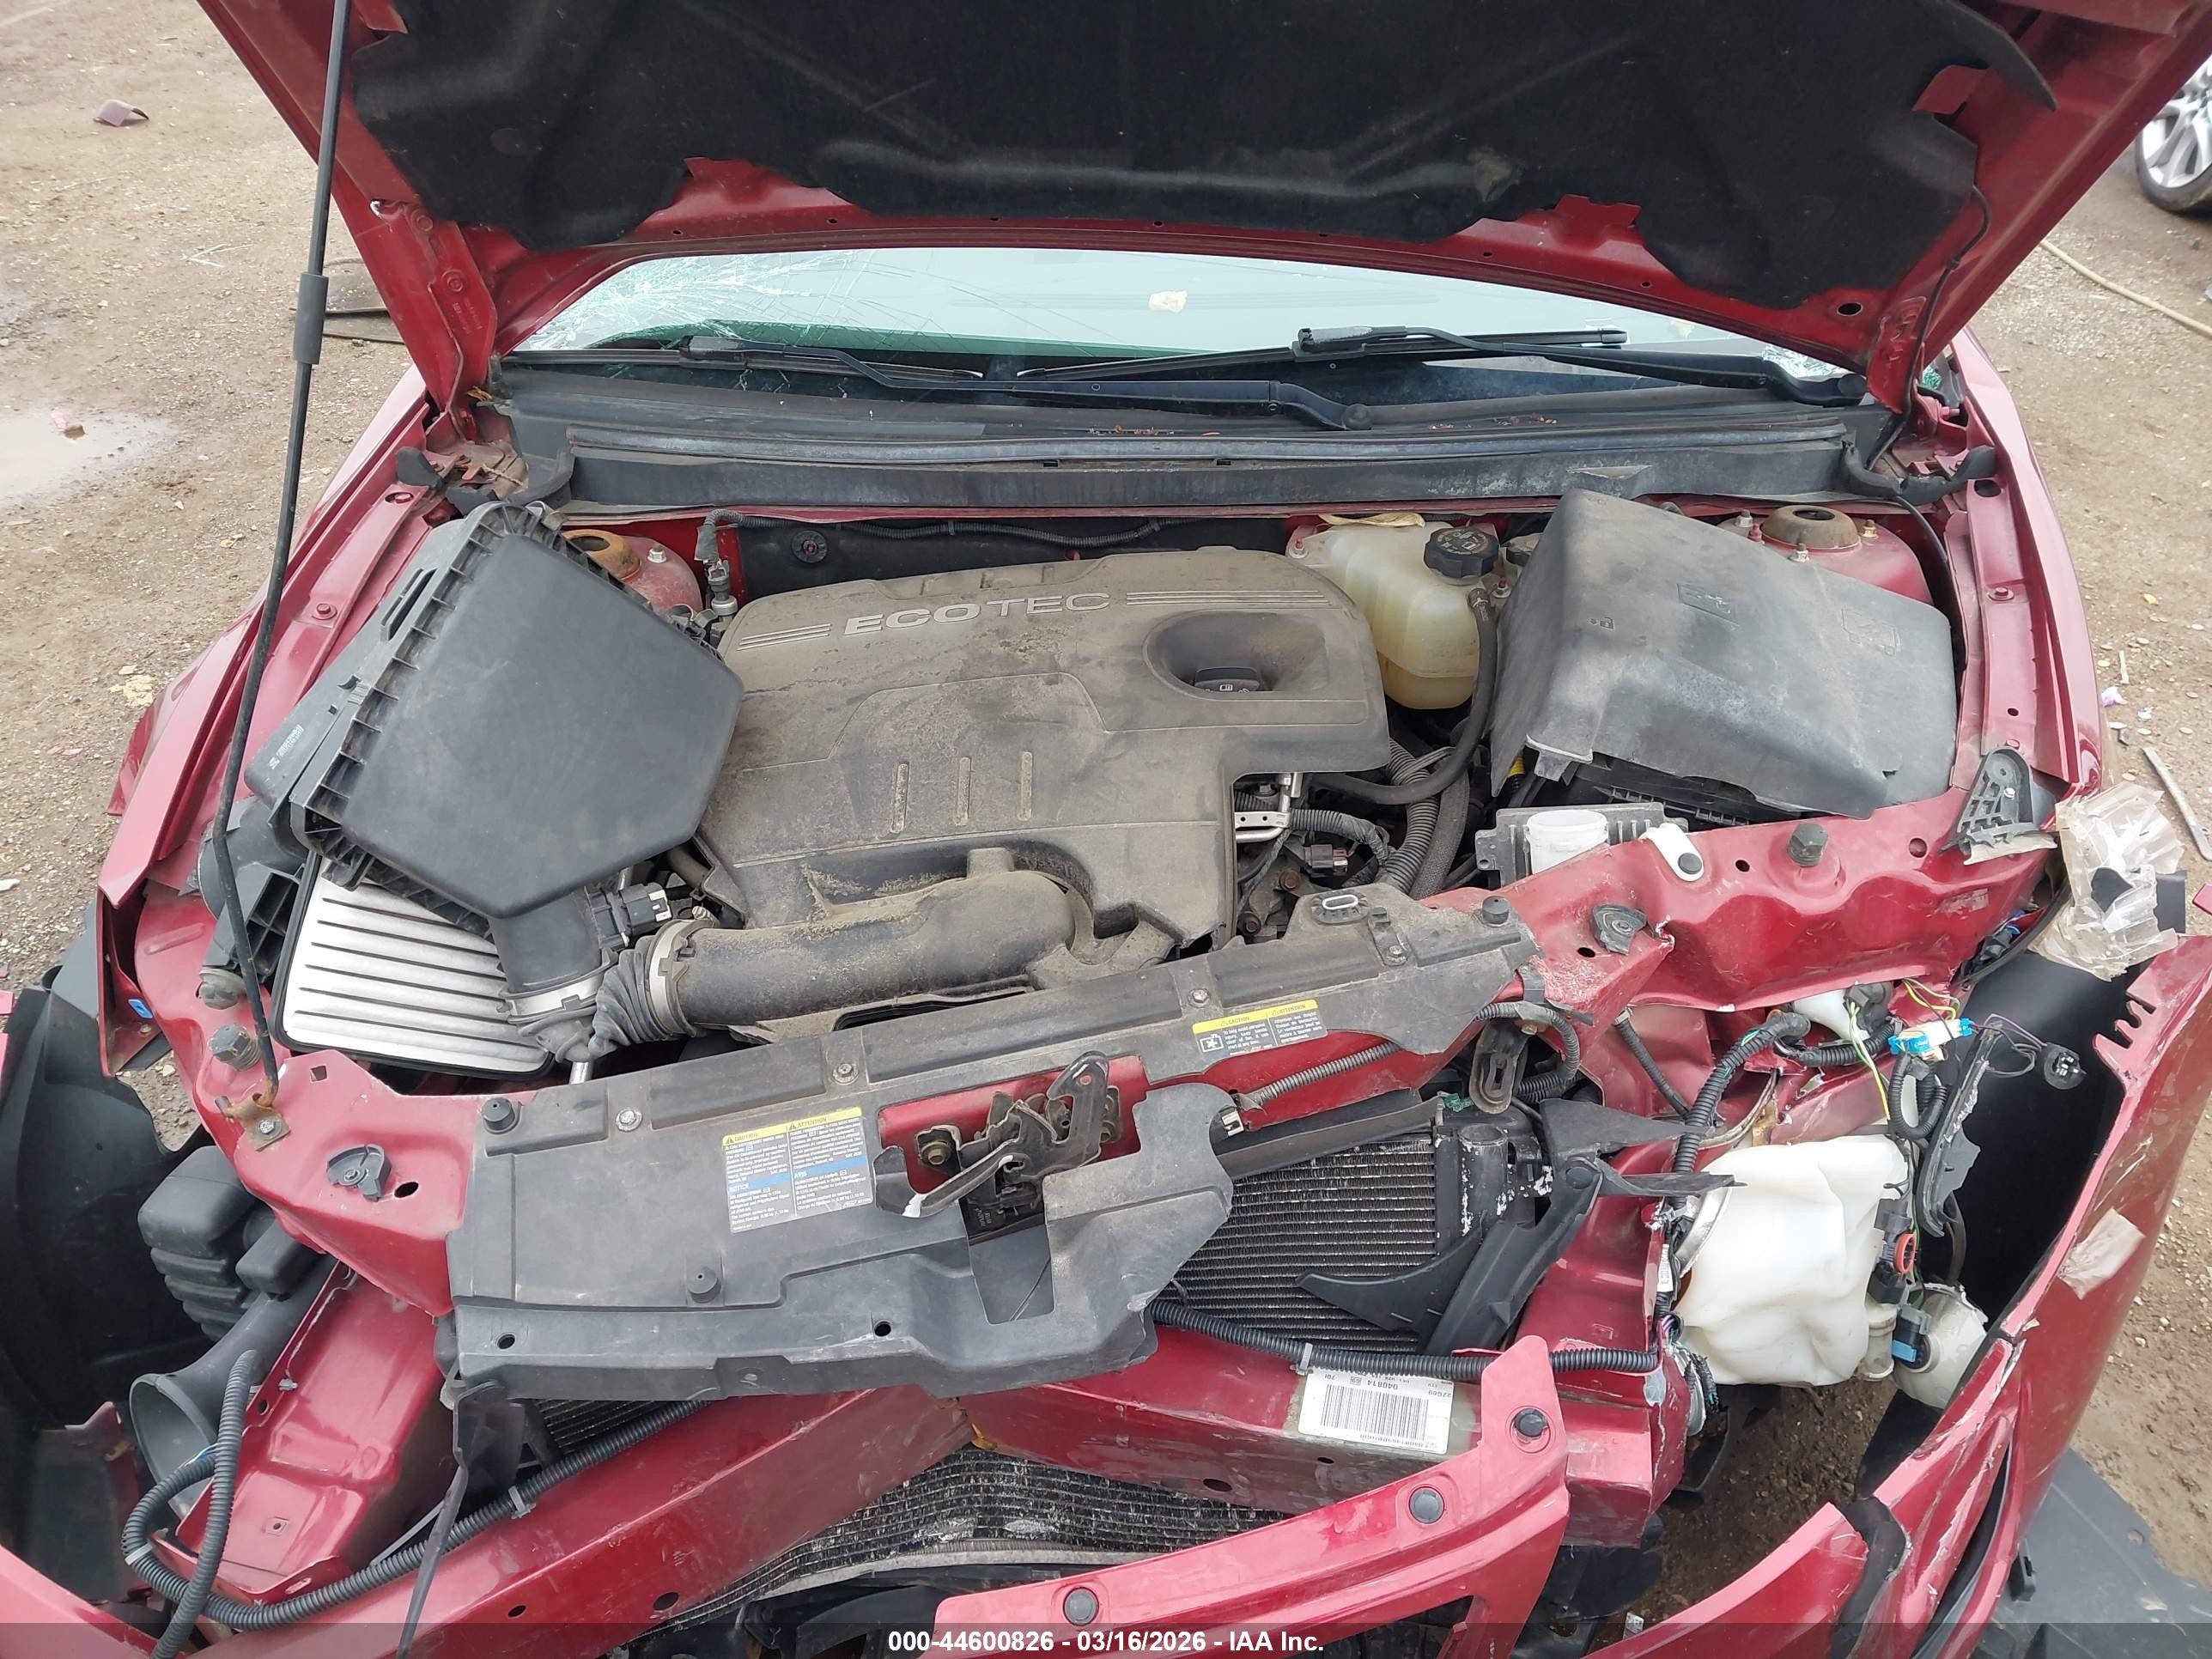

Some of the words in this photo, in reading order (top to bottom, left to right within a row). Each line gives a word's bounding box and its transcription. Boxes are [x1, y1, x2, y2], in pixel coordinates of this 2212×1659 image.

[843, 592, 1110, 636] ECOTEC
[1228, 1016, 1250, 1024] CAUTION
[798, 1116, 827, 1128] ATTENTION
[734, 1132, 758, 1143] CAUTION
[1367, 1379, 1399, 1391] 040814
